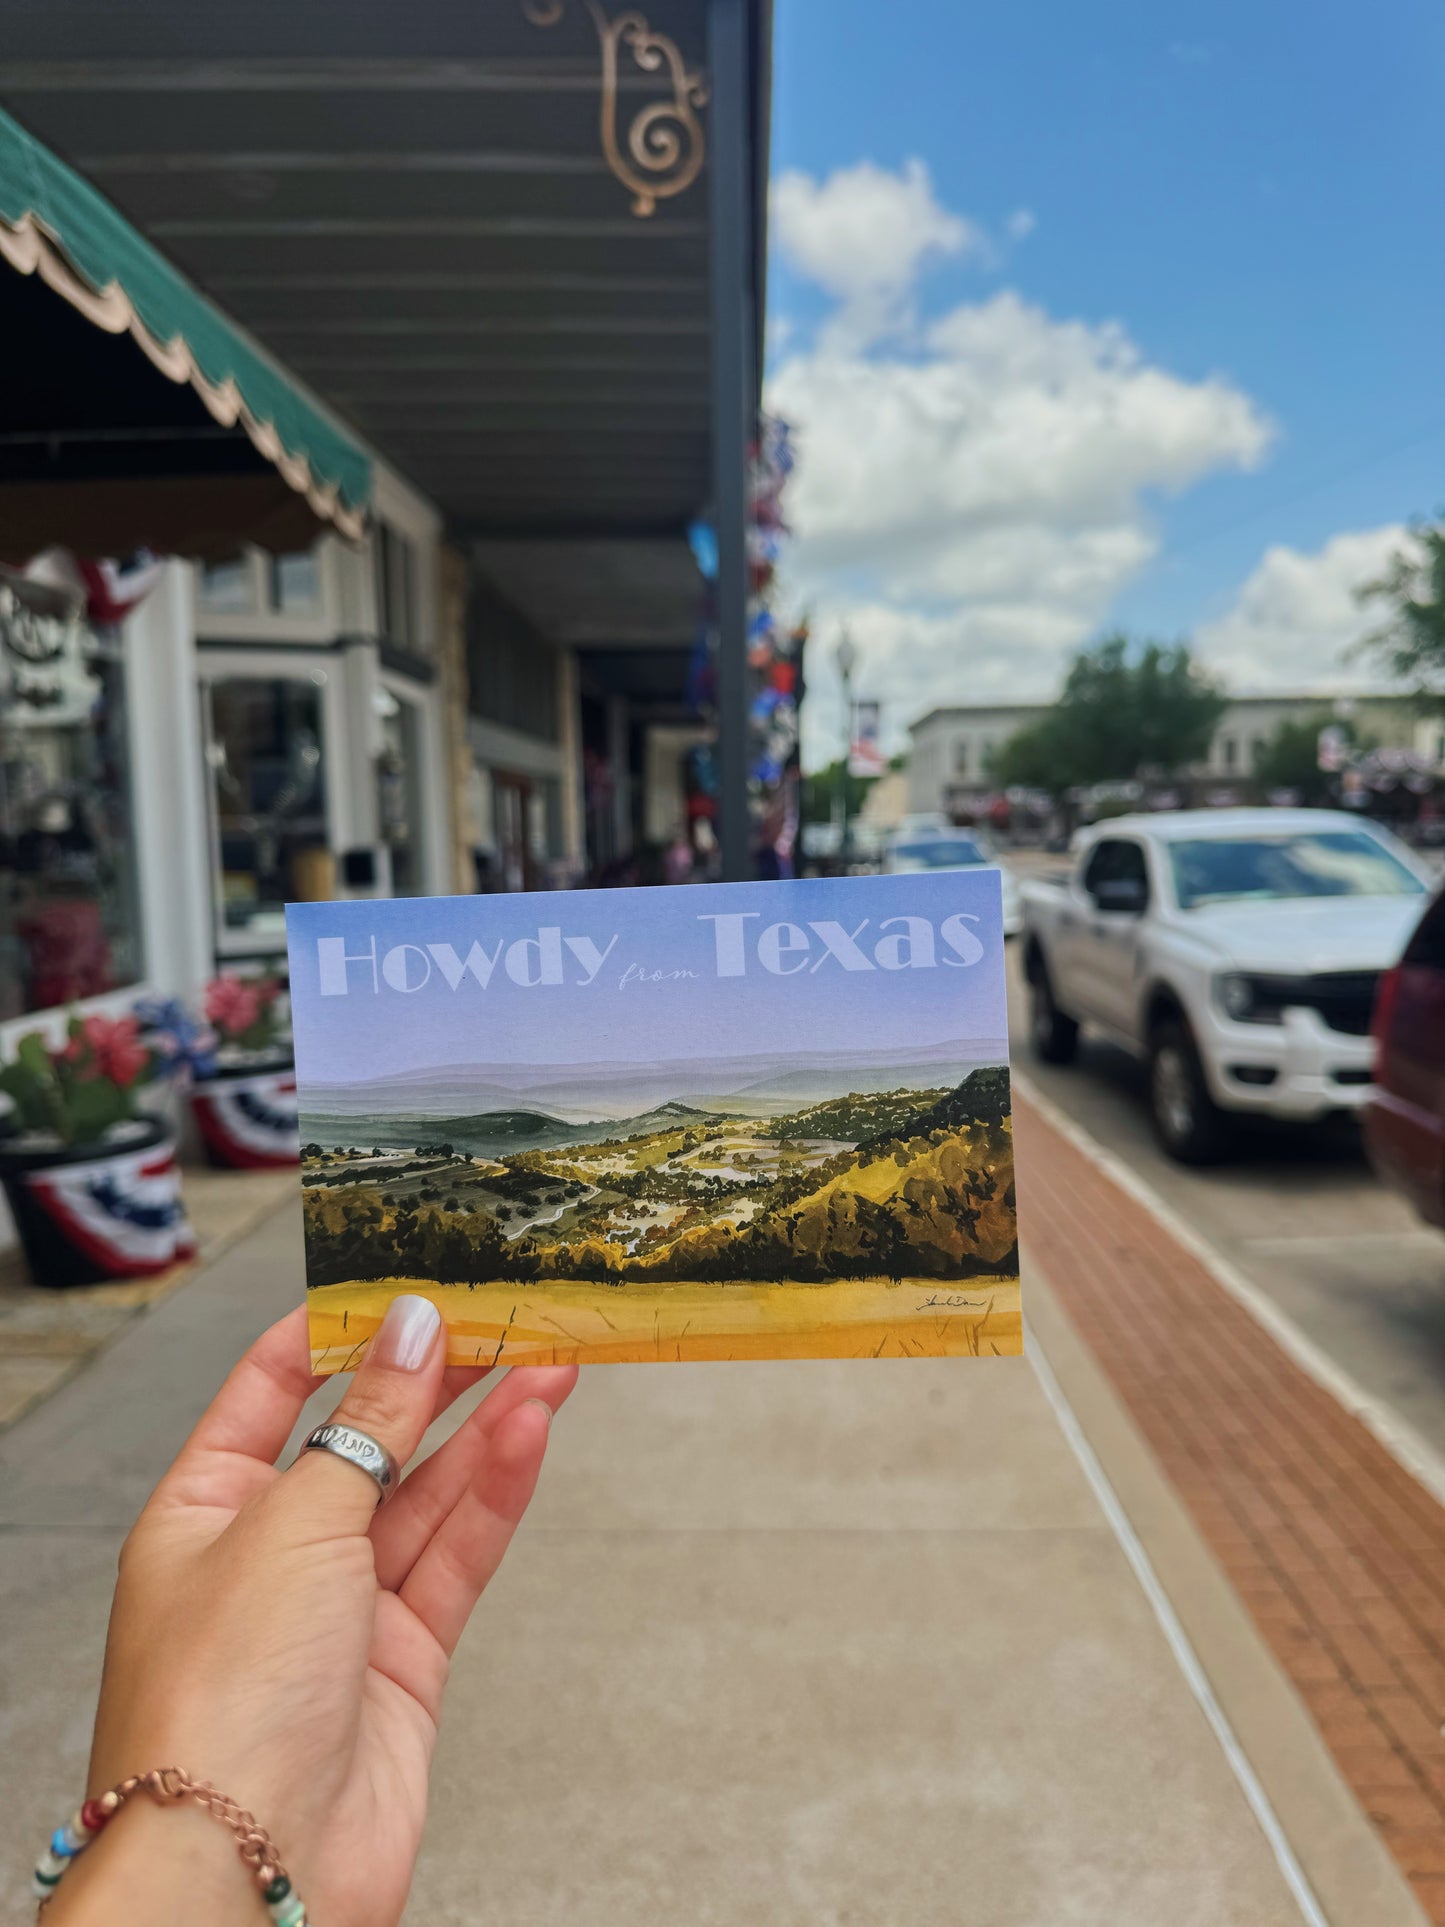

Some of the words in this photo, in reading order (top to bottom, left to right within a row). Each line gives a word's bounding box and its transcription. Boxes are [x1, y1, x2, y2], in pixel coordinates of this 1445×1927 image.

[316, 926, 619, 996] Howdy
[620, 962, 698, 990] from
[698, 912, 984, 977] Texas
